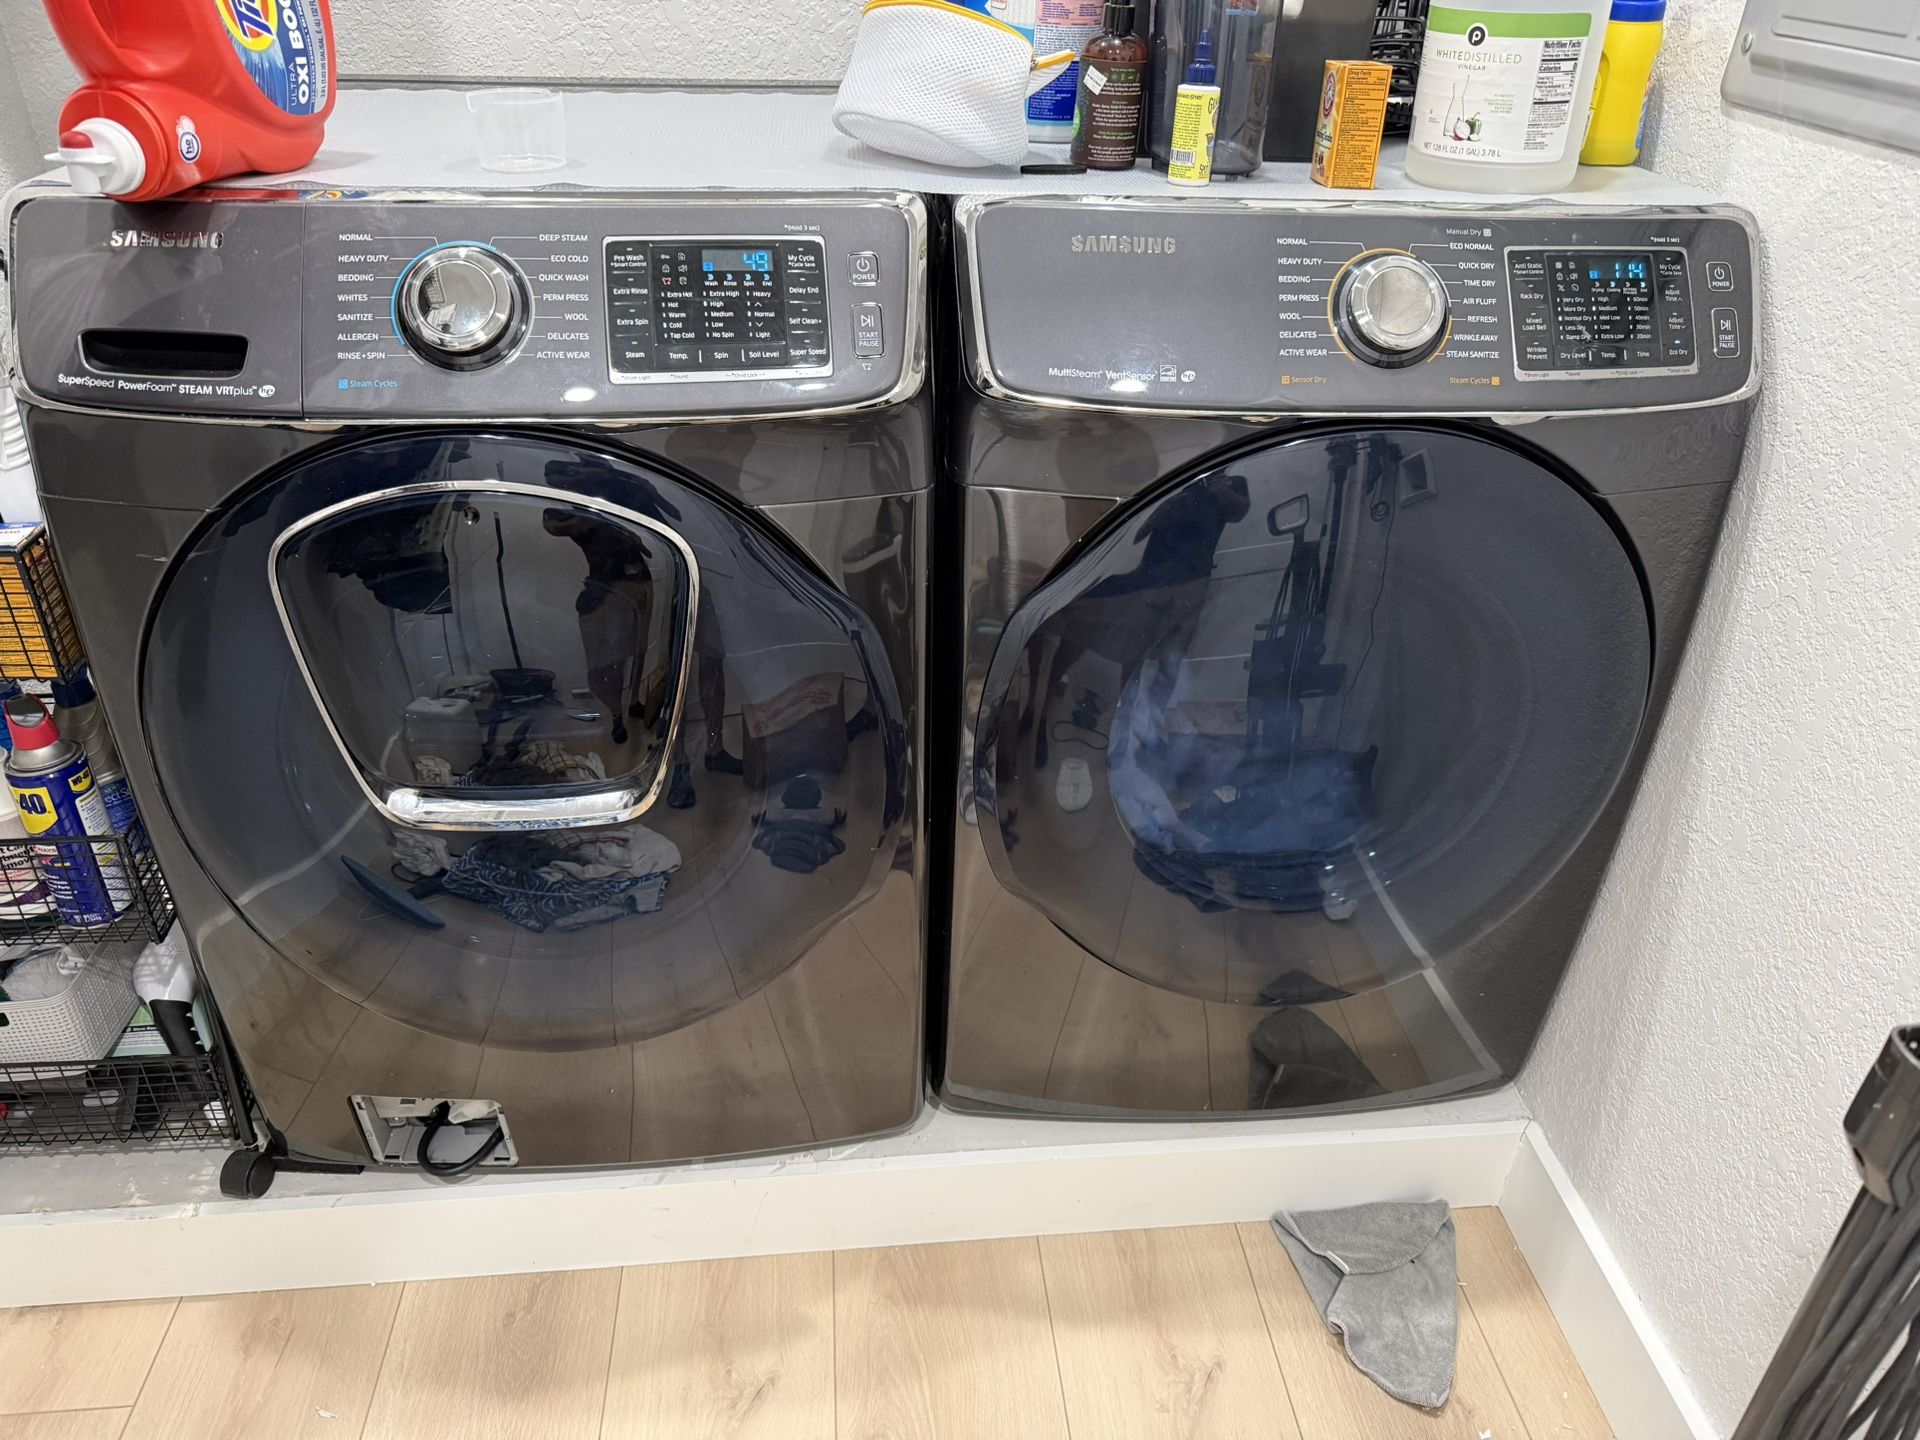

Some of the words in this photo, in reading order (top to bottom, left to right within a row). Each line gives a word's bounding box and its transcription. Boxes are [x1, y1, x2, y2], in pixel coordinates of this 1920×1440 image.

[232, 0, 275, 38] Ti
[289, 62, 297, 105] ULTRA
[296, 57, 310, 104] OXI
[1432, 143, 1442, 152] 128
[1449, 146, 1458, 154] OZ
[1466, 148, 1480, 156] GAL)
[1482, 149, 1496, 158] 3.78
[110, 230, 224, 249] SAMSUNG
[1072, 234, 1176, 254] SAMSUNG
[743, 251, 768, 271] 49
[538, 274, 563, 282] QUICK
[58, 374, 114, 388] SuperSpeed
[179, 385, 212, 394] STEAM
[374, 380, 398, 388] Cycles
[1312, 376, 1327, 384] Dry
[1470, 377, 1490, 385] Cycles
[71, 770, 91, 787] WD-40
